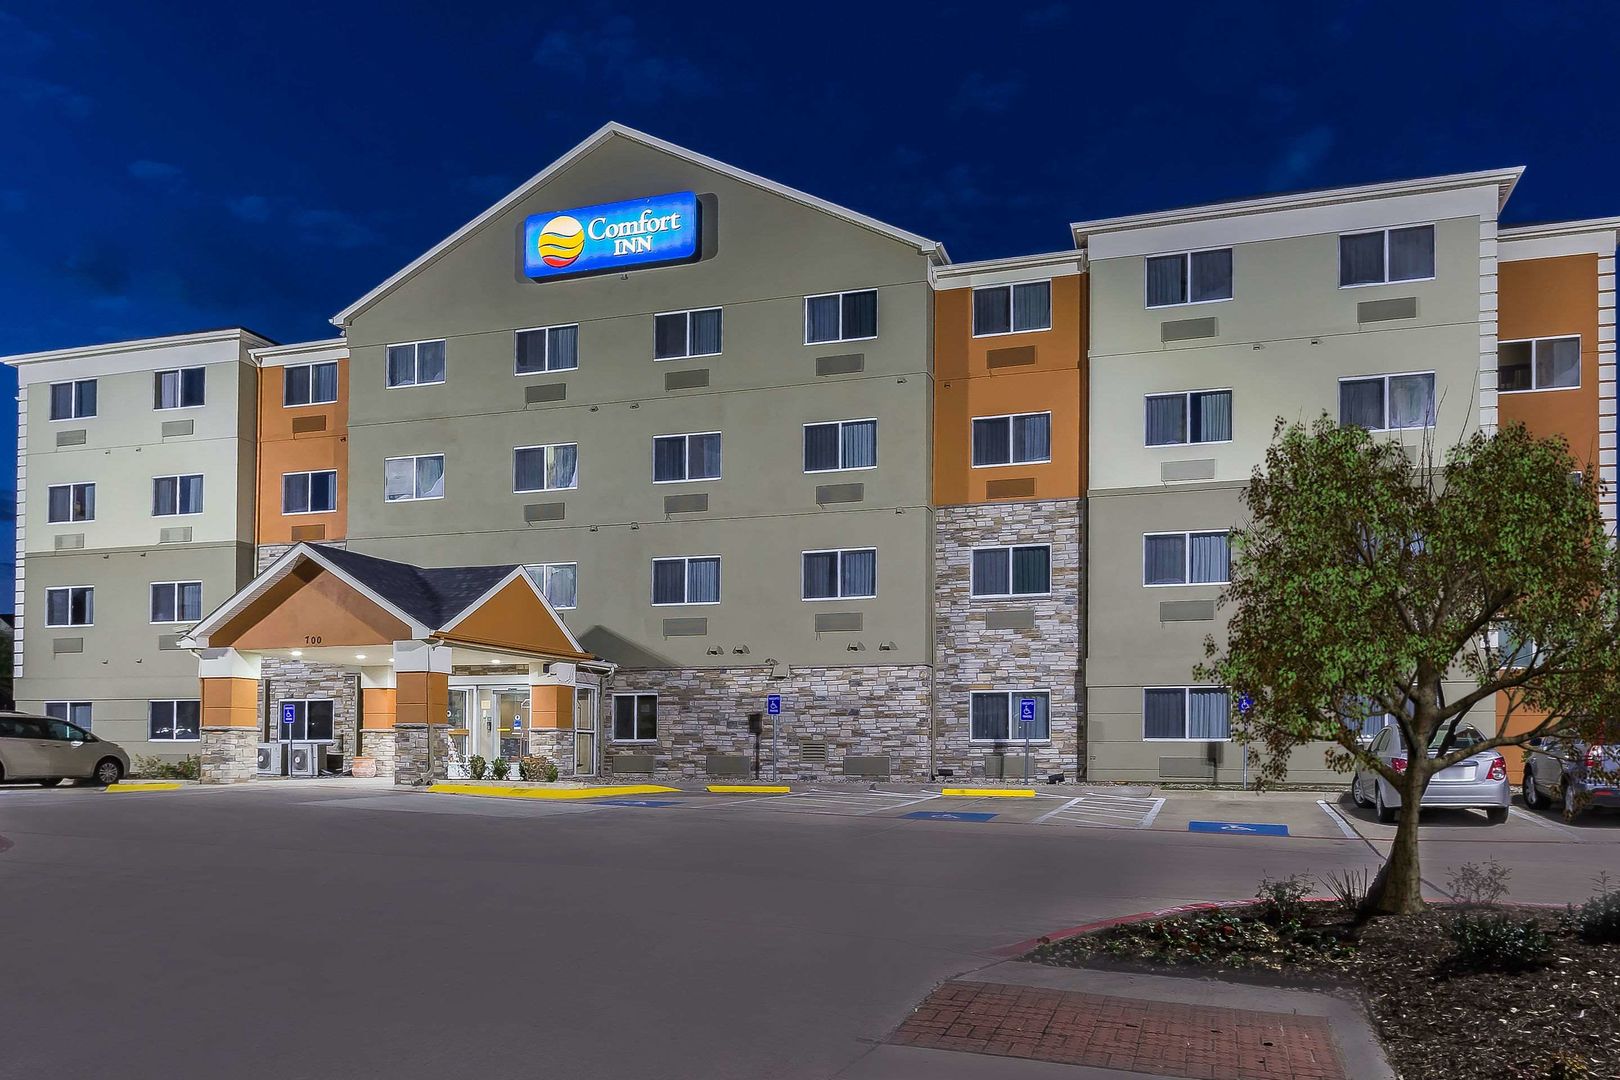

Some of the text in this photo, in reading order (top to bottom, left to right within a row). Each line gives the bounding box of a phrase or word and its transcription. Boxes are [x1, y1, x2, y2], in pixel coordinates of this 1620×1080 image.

[588, 209, 681, 241] Comfort
[613, 235, 654, 256] INN
[304, 635, 322, 645] 700
